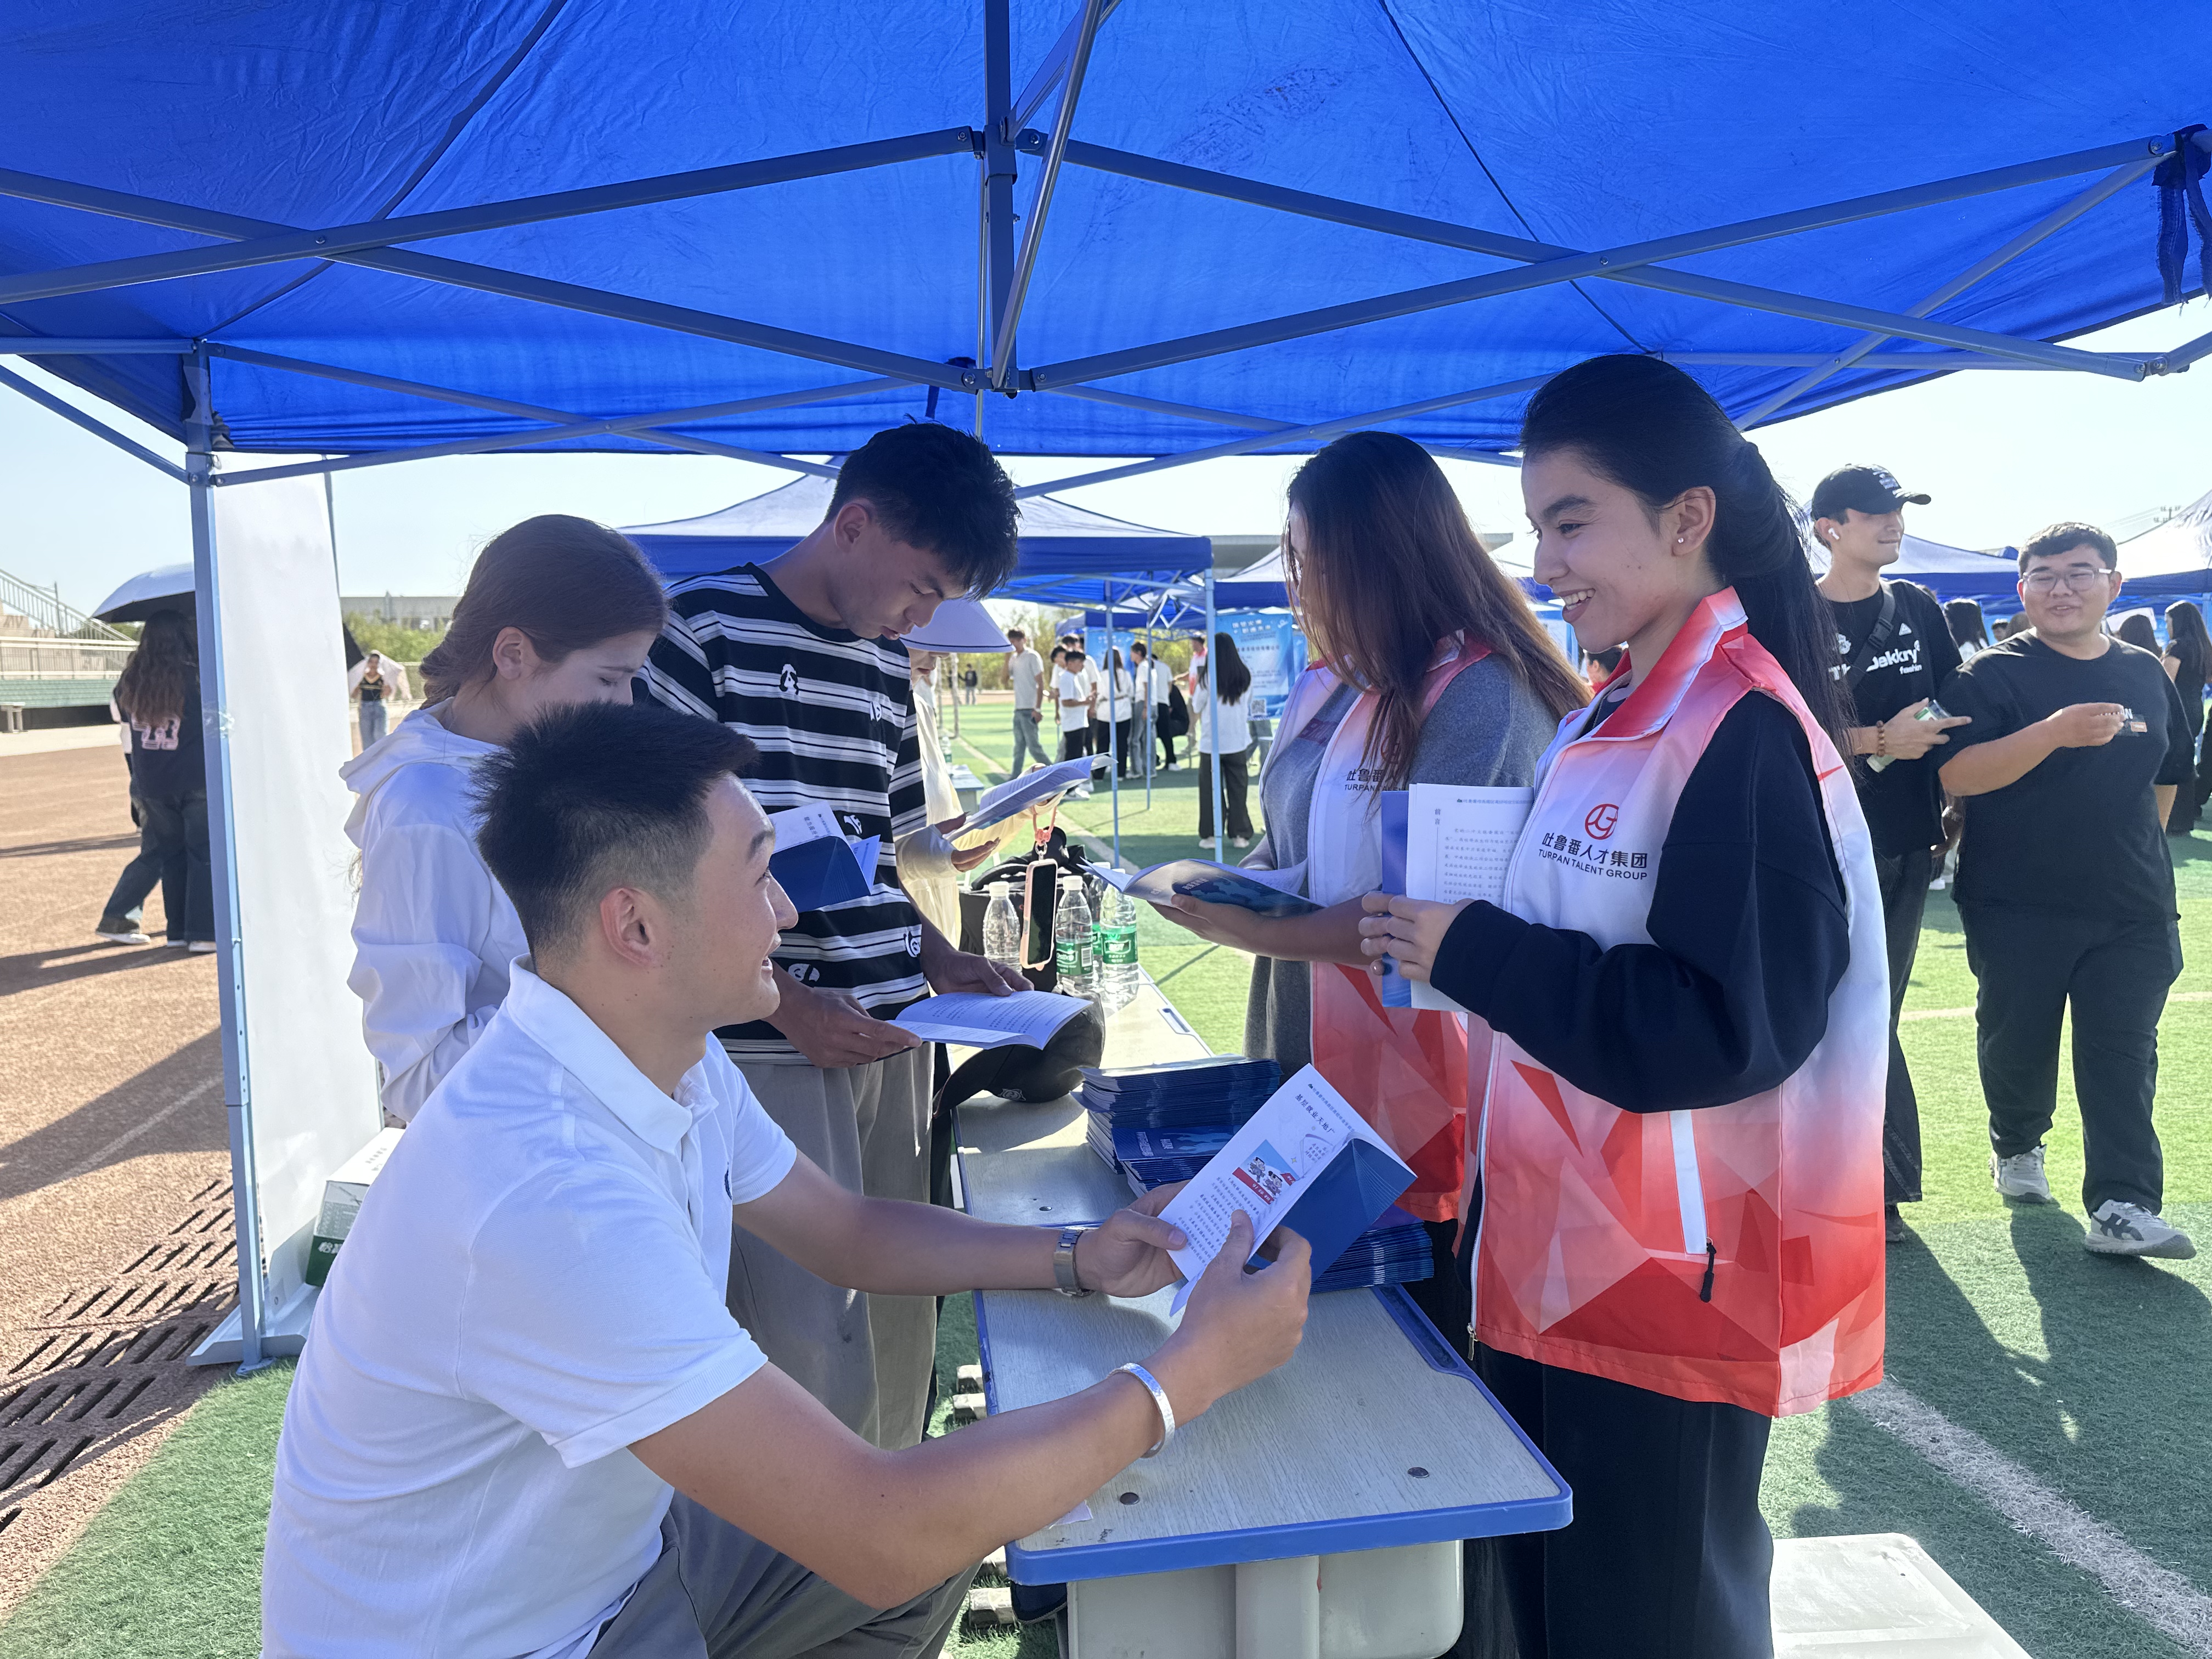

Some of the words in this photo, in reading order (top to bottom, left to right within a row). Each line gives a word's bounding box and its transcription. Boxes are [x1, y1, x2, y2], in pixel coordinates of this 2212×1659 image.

[1538, 849, 1570, 866] TURPAN
[1571, 859, 1604, 876] TALENT
[1606, 869, 1648, 881] GROUP
[1541, 832, 1648, 869] 吐鲁番人才集团
